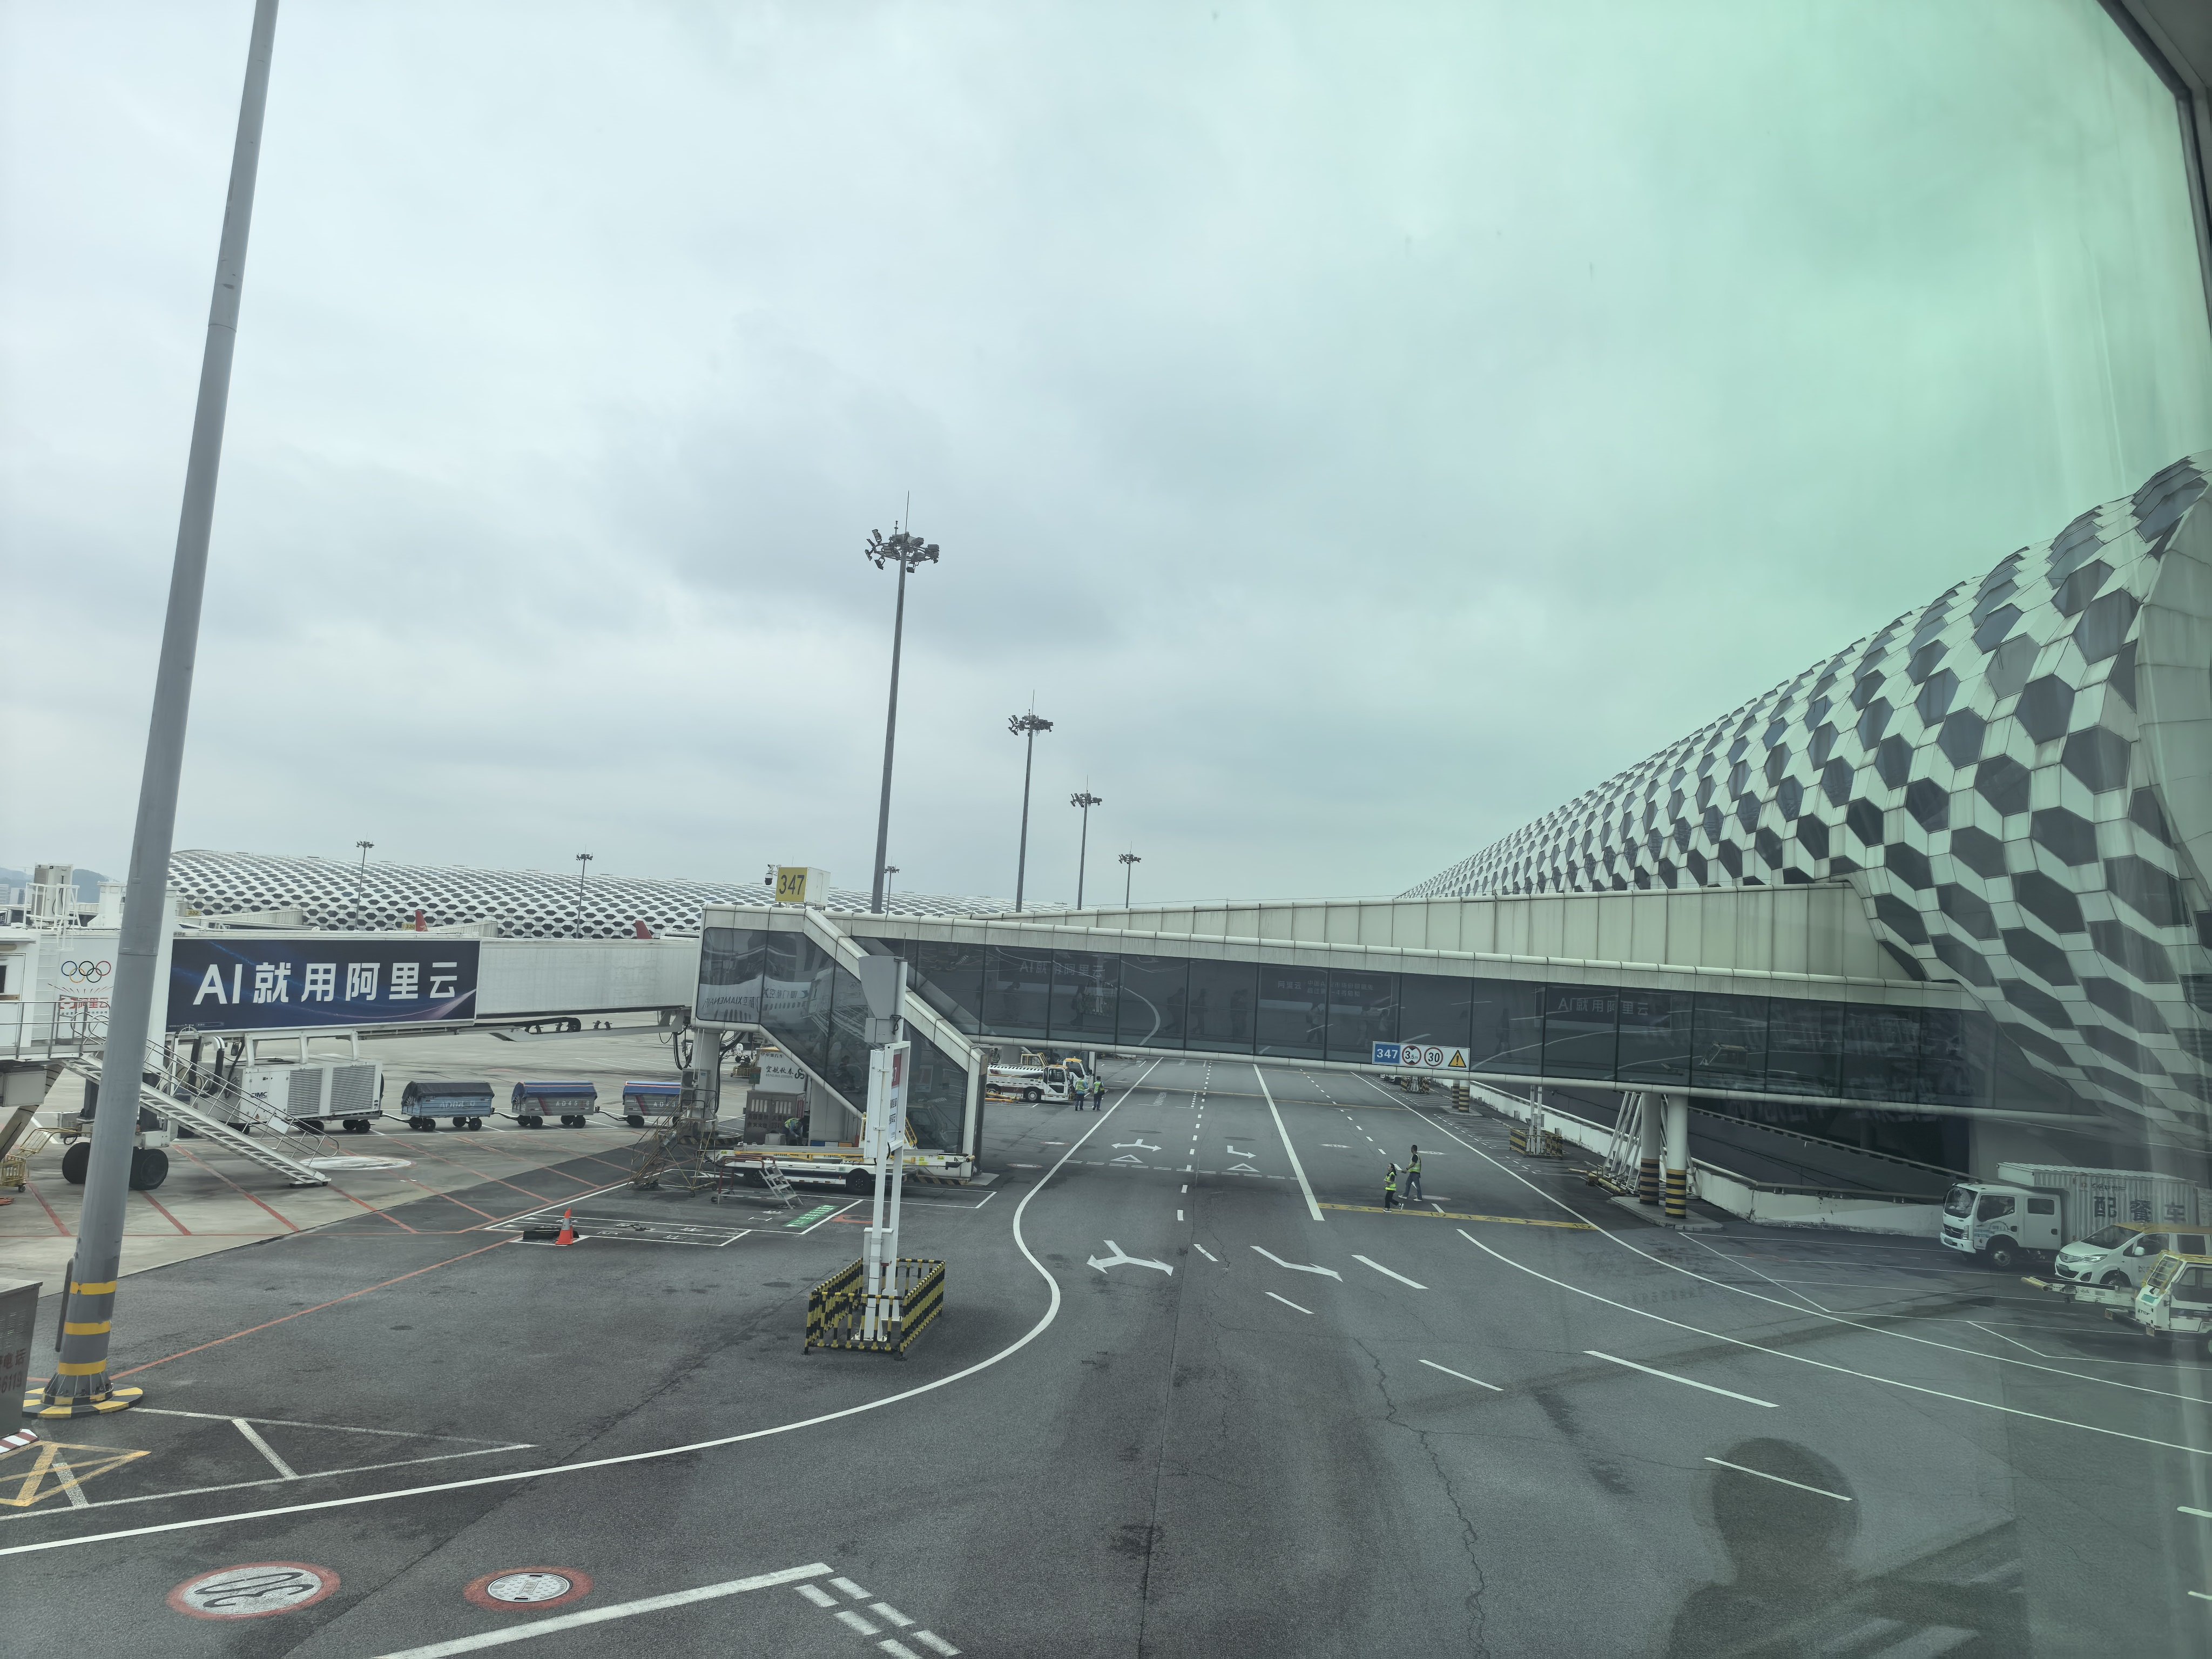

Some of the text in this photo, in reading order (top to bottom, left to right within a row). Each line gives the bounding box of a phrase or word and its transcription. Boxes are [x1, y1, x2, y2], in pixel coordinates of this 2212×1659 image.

[779, 874, 805, 895] 347
[1377, 1048, 1398, 1059] 347
[1428, 1052, 1440, 1063] 30
[2094, 1196, 2187, 1224] 配餐车
[193, 1572, 316, 1608] 30
